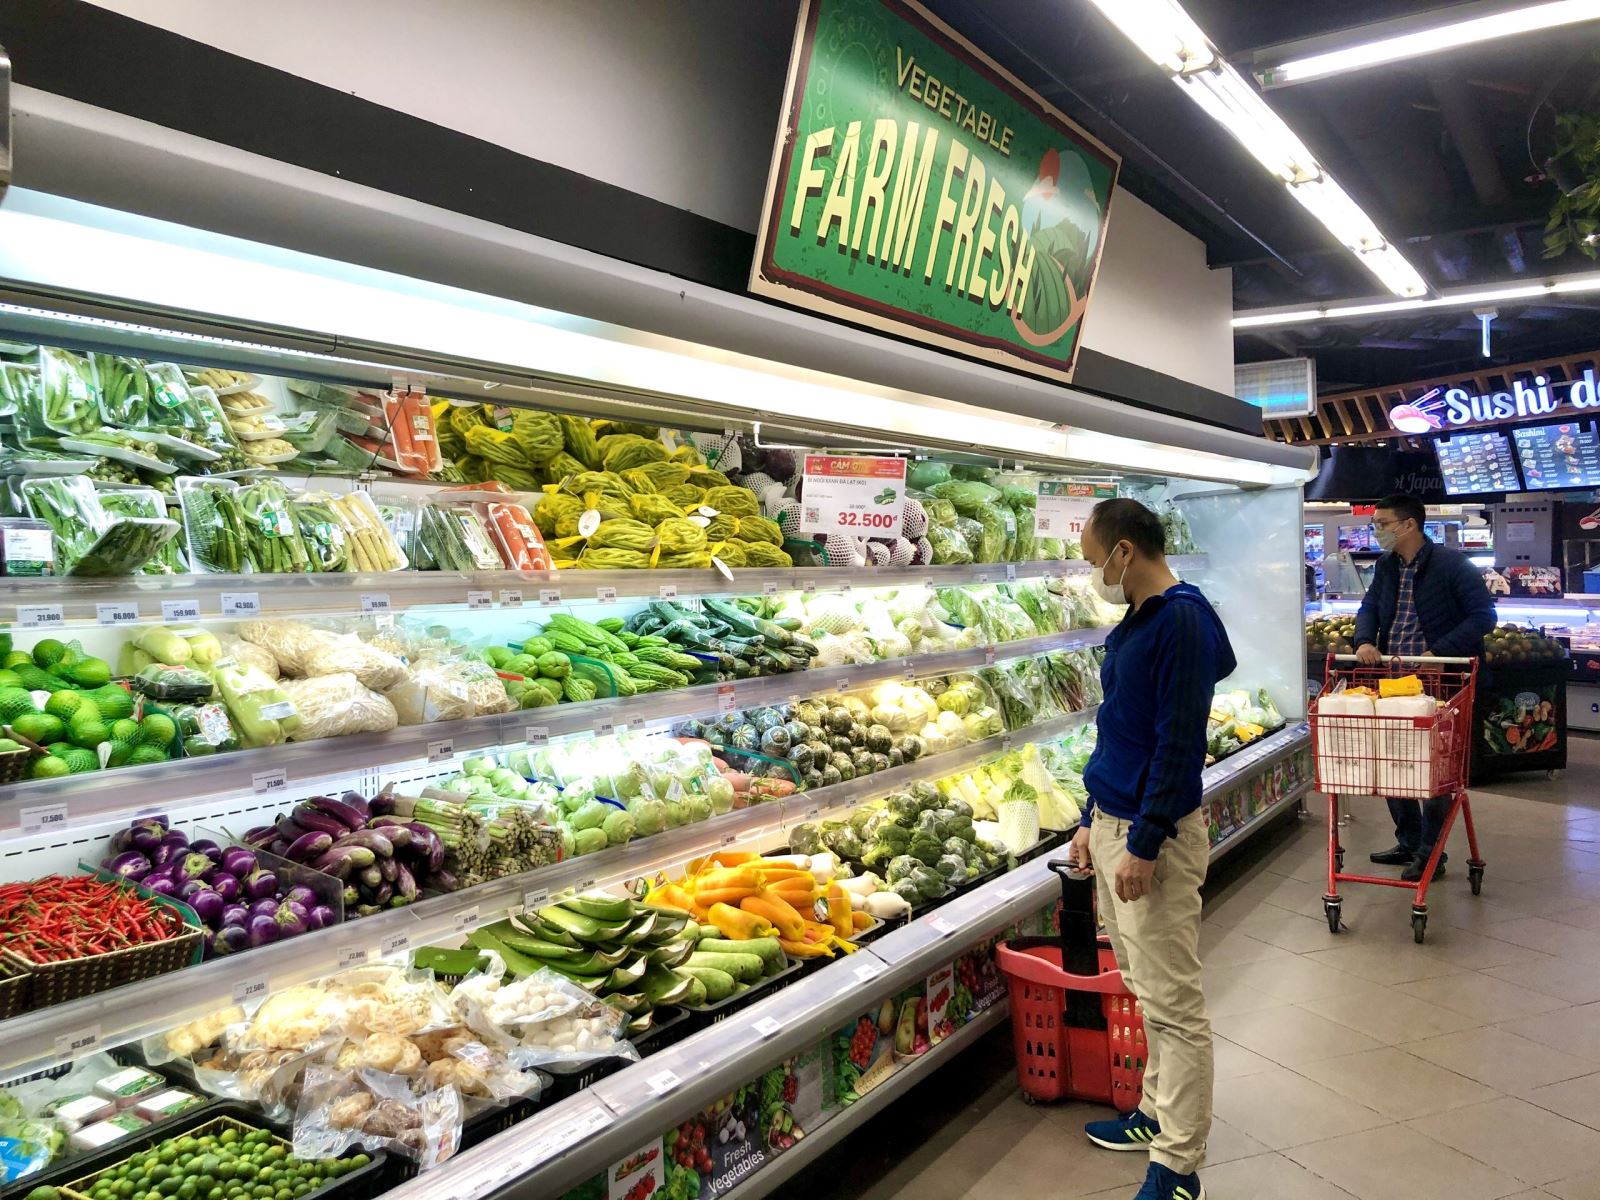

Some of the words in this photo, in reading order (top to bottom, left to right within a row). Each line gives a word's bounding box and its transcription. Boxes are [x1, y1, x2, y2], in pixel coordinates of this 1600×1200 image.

[896, 46, 1014, 154] VEGETABLE
[790, 118, 940, 276] FARM
[924, 138, 1036, 317] FRESH
[1444, 375, 1560, 424] Sushi
[1515, 427, 1546, 439] Sashimi
[708, 1150, 764, 1193] Vegetables
[724, 1140, 751, 1168] Fresh
